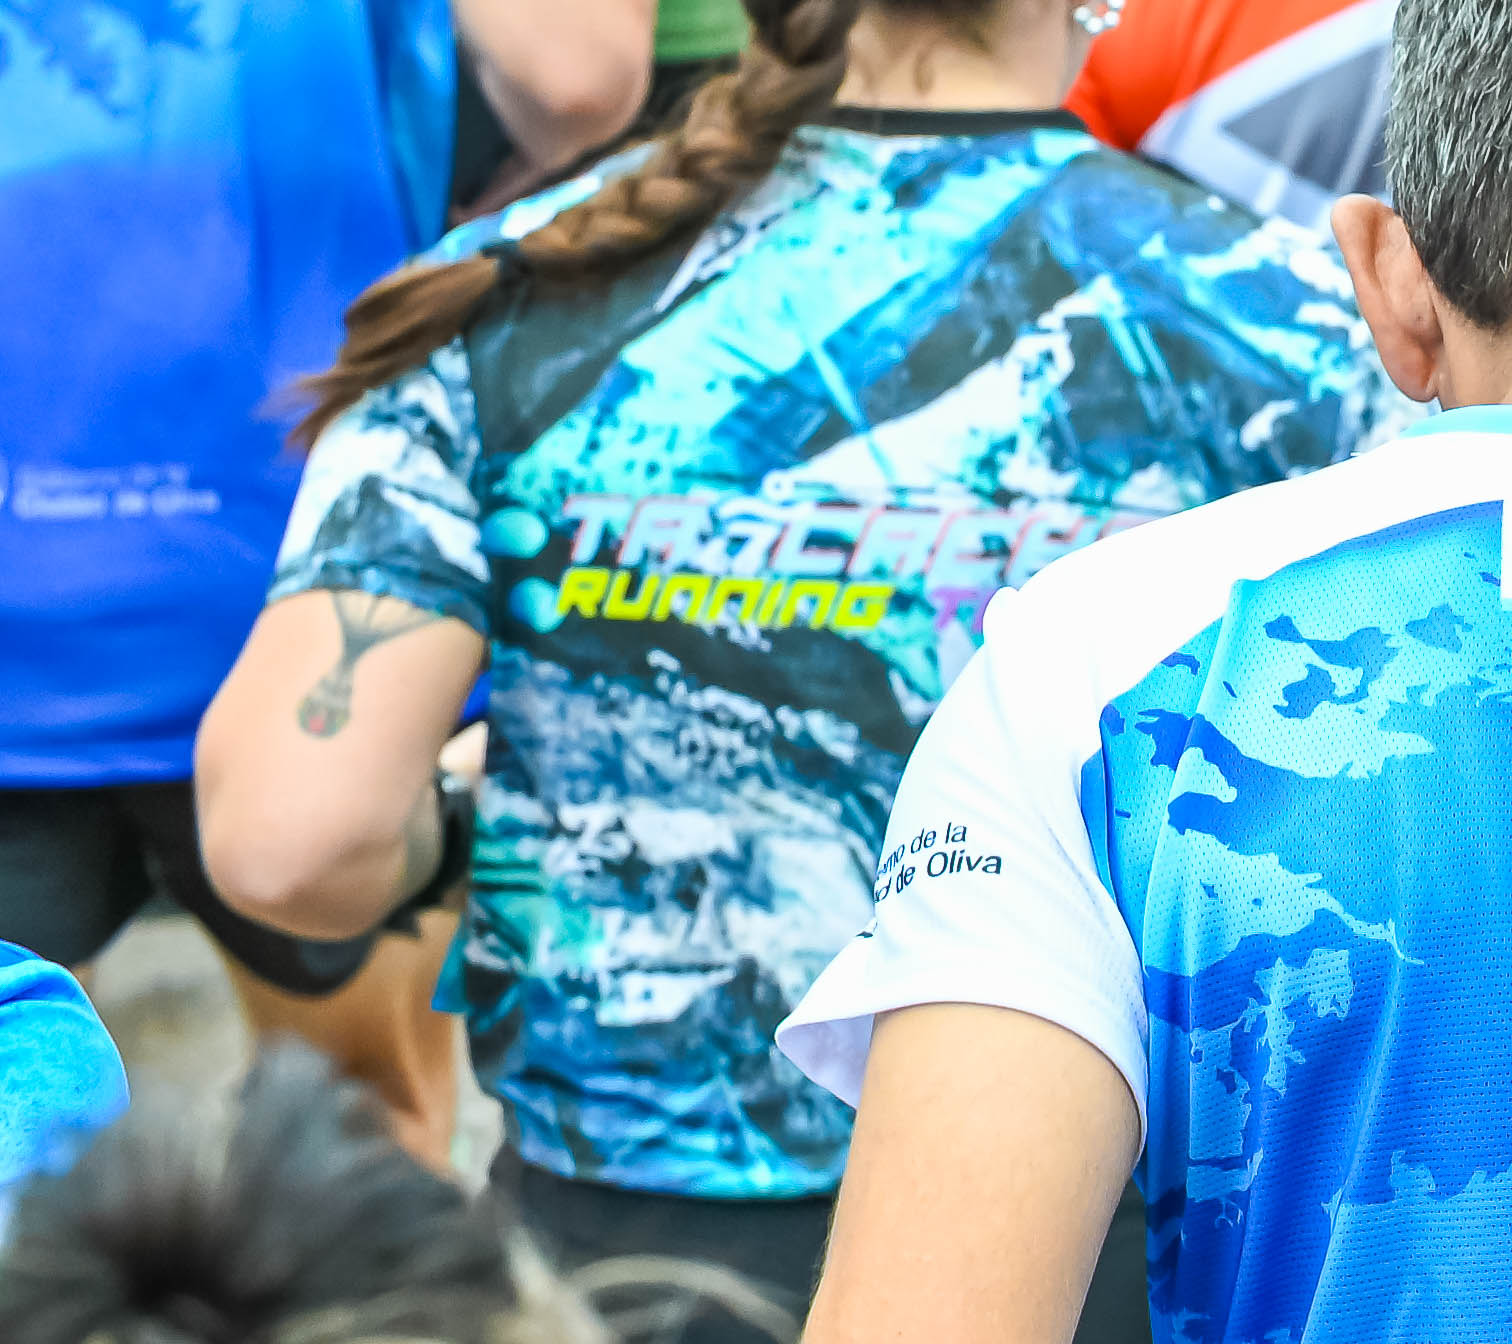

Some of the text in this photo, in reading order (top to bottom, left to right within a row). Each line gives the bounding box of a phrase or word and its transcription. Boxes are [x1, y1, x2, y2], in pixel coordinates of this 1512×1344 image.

[556, 566, 896, 630] RUNNING
[911, 821, 968, 854] de la
[896, 863, 916, 894] de
[926, 849, 1002, 878] Oliva
